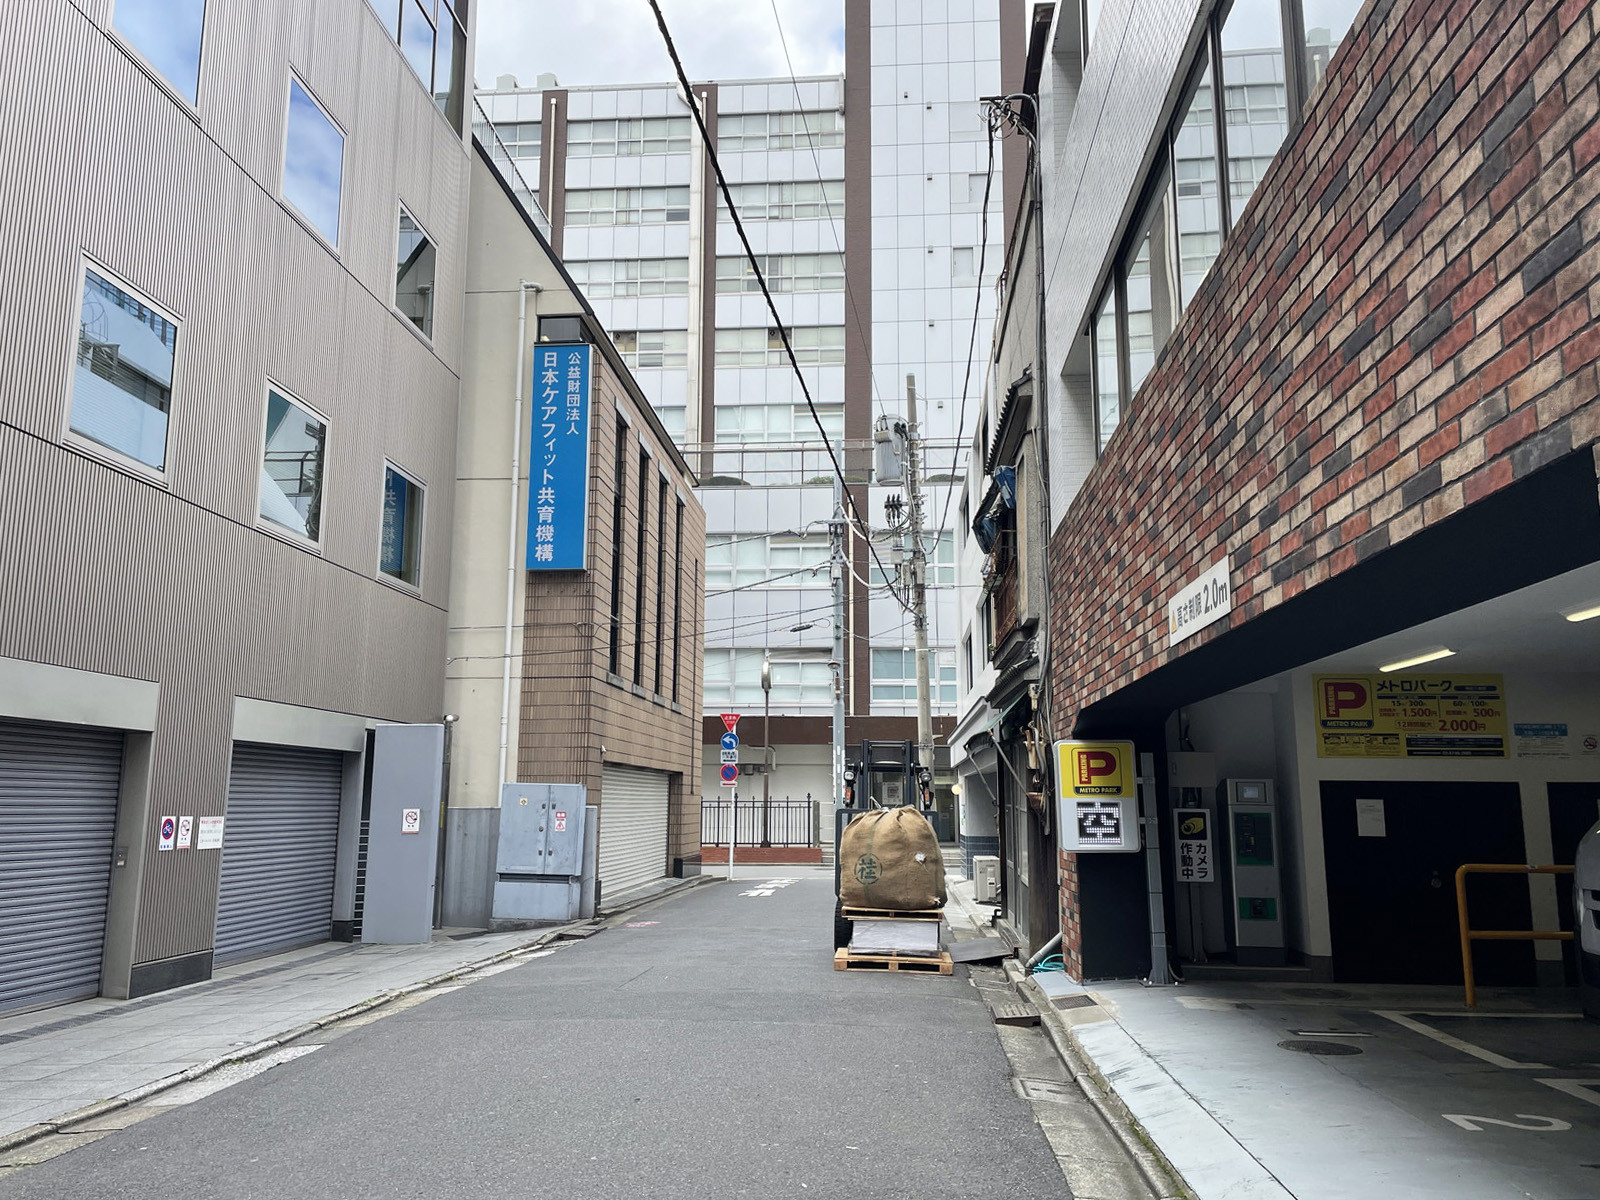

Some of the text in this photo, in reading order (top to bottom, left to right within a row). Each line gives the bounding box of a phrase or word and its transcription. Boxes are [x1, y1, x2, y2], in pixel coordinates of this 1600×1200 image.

[566, 352, 581, 435] 公益財団法人
[534, 352, 558, 562] 日本ケアフィット共育機構
[1177, 578, 1228, 628] 高さ制限 2.0m
[1377, 680, 1452, 691] メトロパーク
[1078, 751, 1116, 784] P
[1080, 754, 1088, 782] PARKING
[1076, 802, 1120, 844] 空
[1180, 842, 1194, 879] 作動中
[1196, 843, 1208, 878] カメラ
[1441, 1113, 1573, 1131] 2
